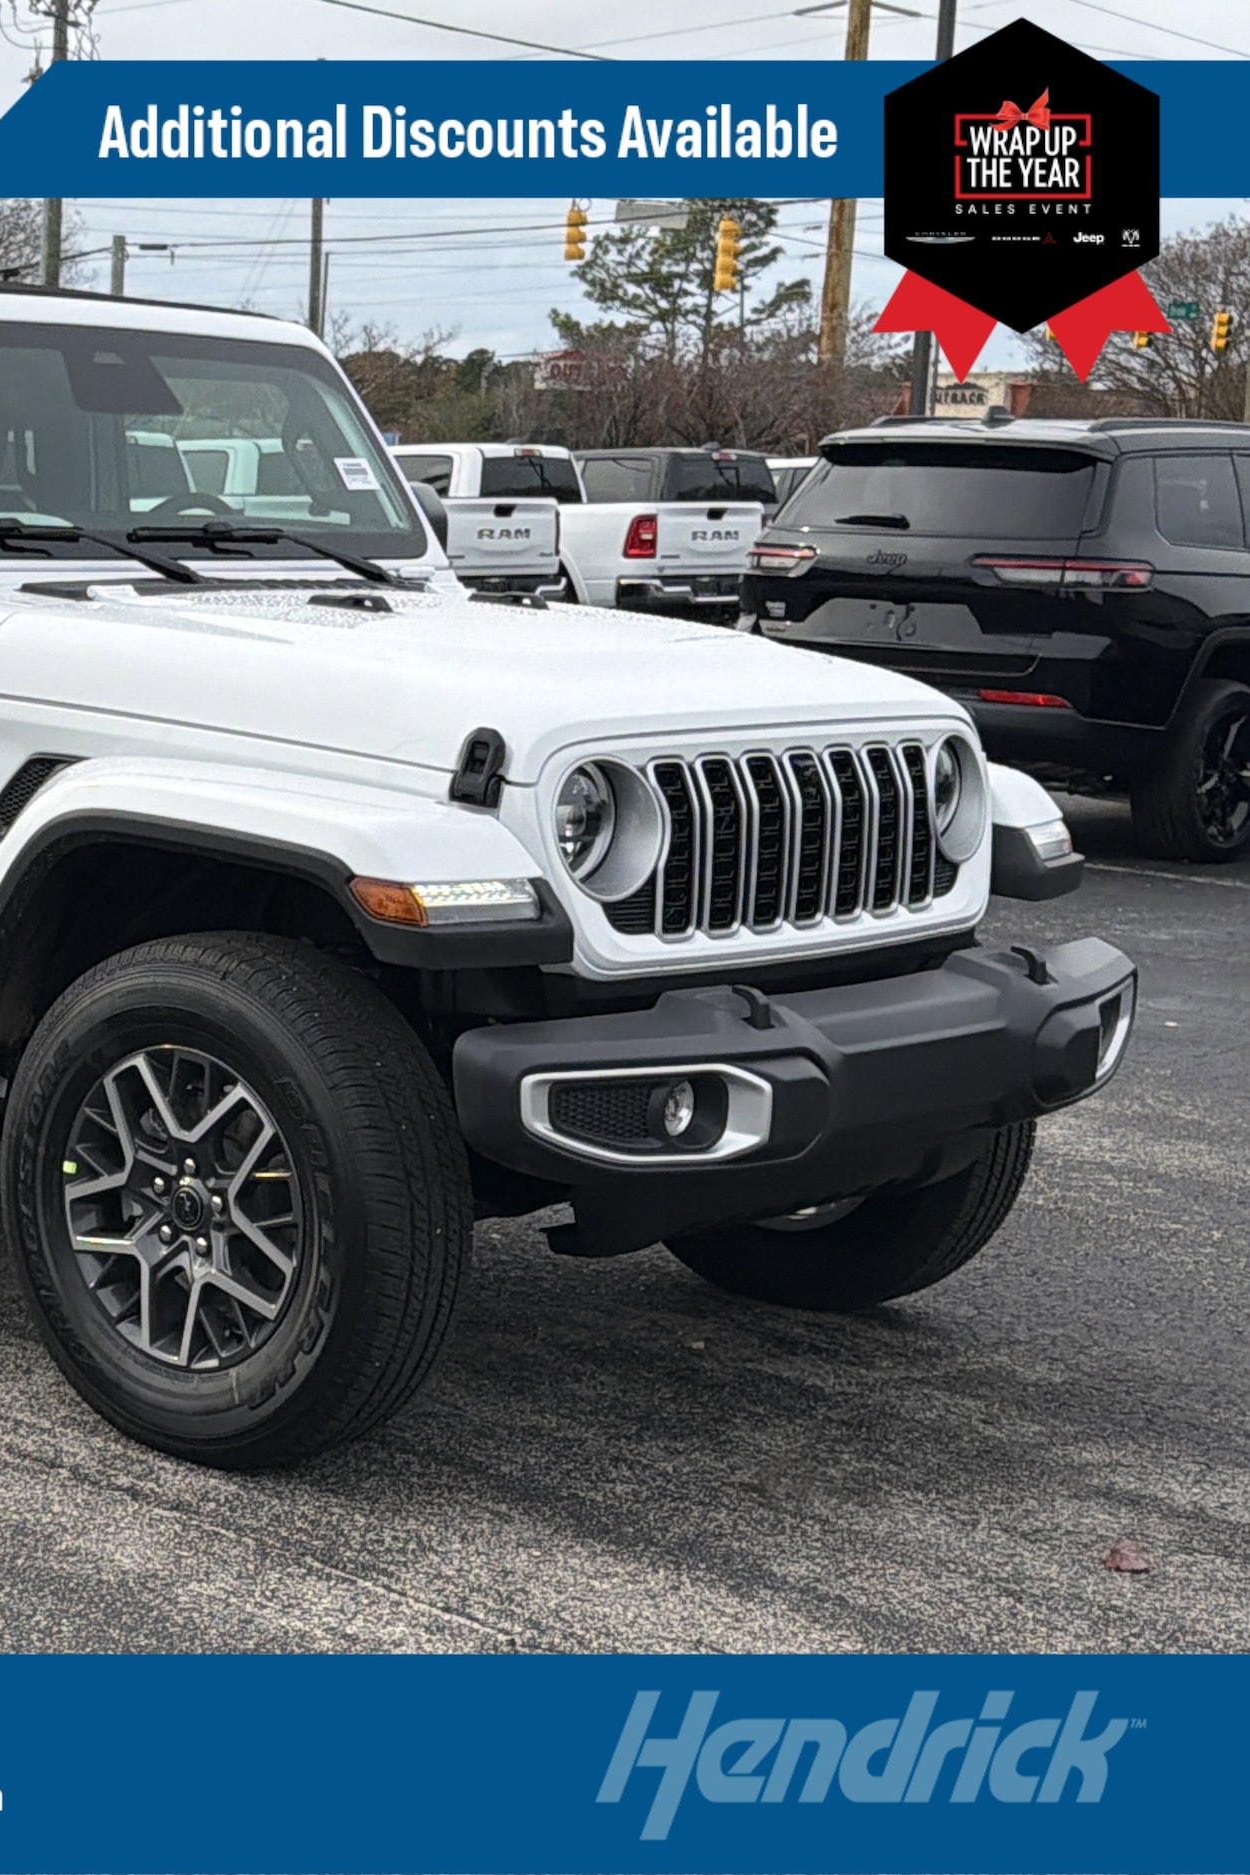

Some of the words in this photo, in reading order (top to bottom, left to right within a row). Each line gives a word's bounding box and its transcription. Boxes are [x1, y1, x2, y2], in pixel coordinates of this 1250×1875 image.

[477, 527, 531, 540] RAM
[691, 530, 739, 541] RAM
[866, 549, 907, 568] Jeep
